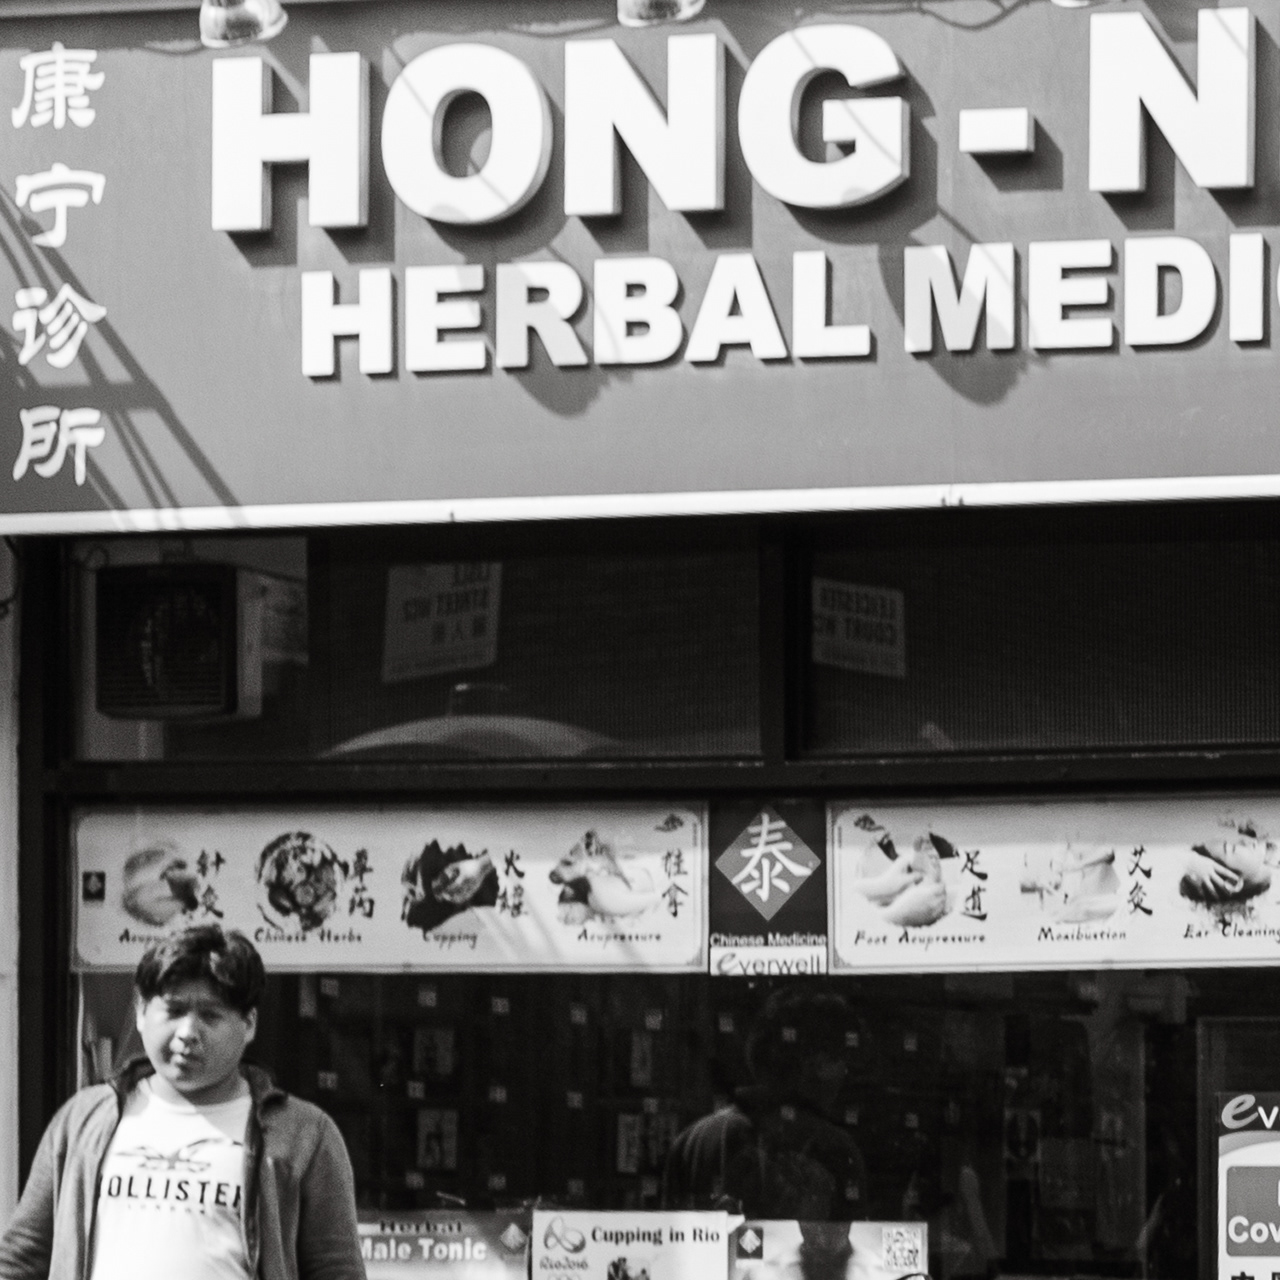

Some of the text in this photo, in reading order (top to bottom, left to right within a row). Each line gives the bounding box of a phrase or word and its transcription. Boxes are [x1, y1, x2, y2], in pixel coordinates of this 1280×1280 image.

[210, 22, 912, 234] HONG
[11, 42, 107, 486] 康宁诊所
[301, 250, 873, 378] HERBAL
[731, 812, 813, 902] 泰
[709, 930, 827, 948] Chinese Medicine
[102, 1174, 242, 1209] OLLISTE
[417, 1236, 488, 1261] Tonic
[591, 1225, 721, 1246] Cupping in Rio
